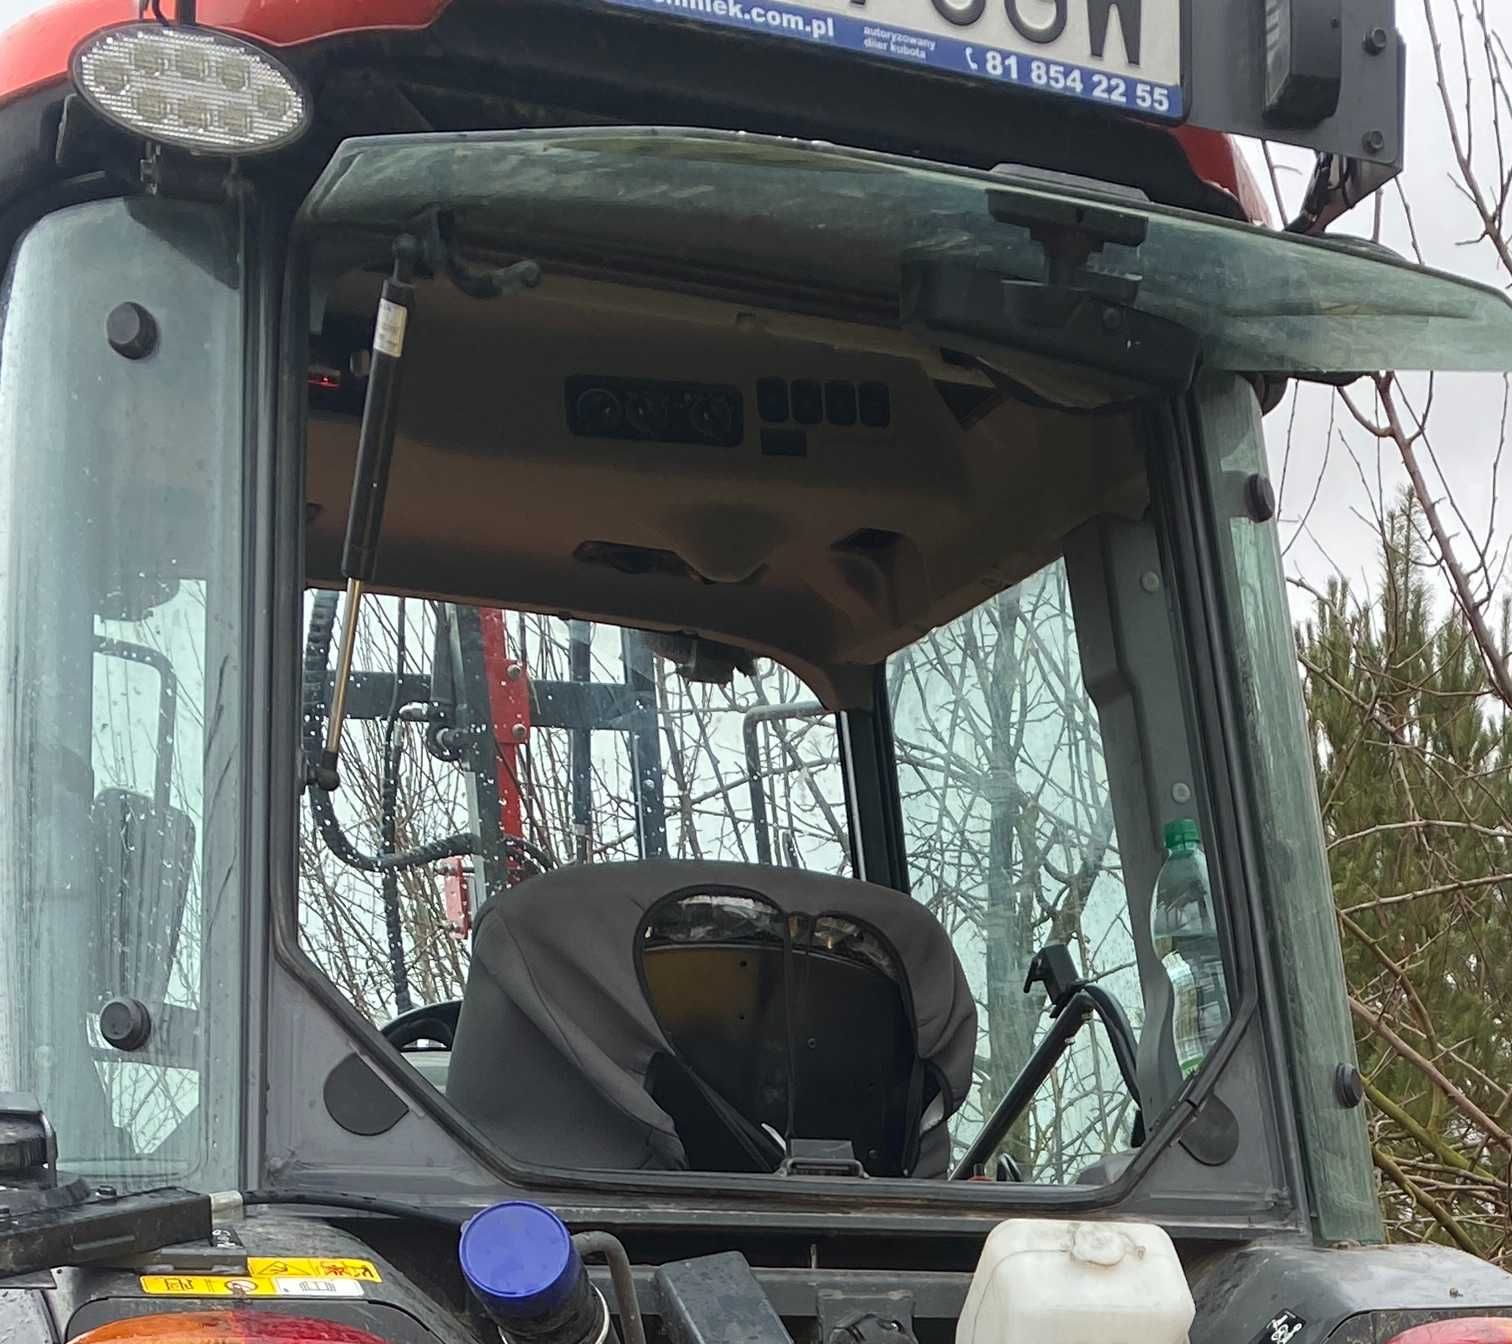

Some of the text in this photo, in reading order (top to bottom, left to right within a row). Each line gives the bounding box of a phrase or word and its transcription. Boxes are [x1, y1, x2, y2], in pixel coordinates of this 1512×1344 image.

[863, 25, 937, 50] autoryzowany
[890, 43, 927, 60] kubota
[985, 51, 1170, 112] 81 854 22 55
